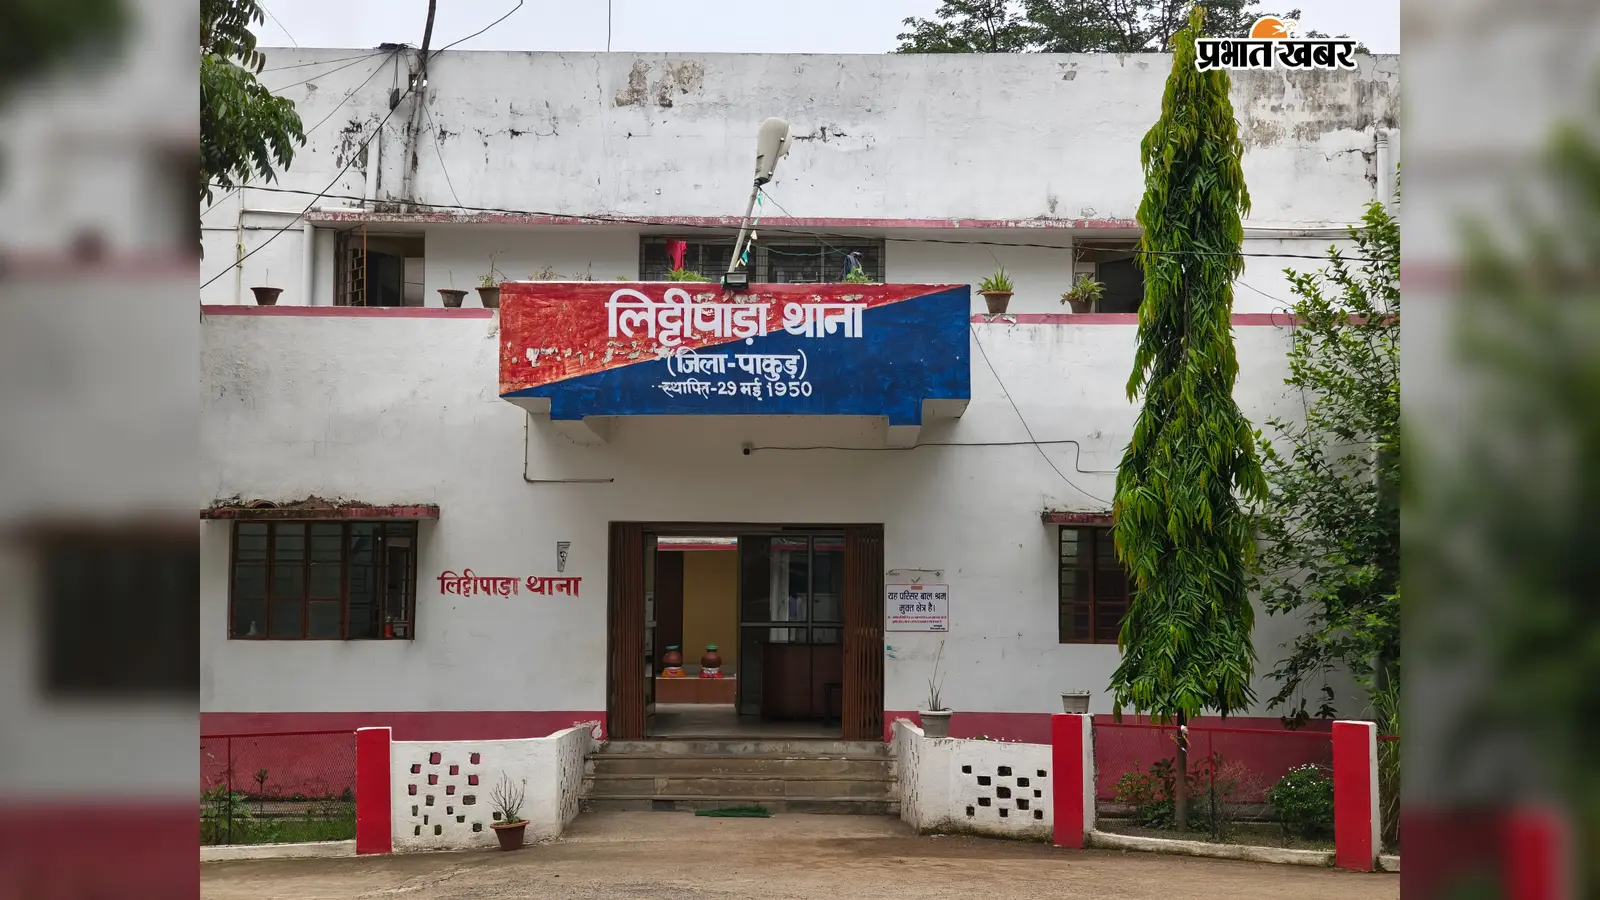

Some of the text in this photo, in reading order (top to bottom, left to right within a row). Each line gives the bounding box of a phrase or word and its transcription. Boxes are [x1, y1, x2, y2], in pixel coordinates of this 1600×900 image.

[605, 288, 867, 347] लिट्टीपाड़ा थाना
[667, 346, 808, 381] (जिला-पाकुड़)
[739, 377, 763, 401] मई
[766, 381, 813, 397] 1950
[437, 568, 582, 599] लिट्टीपाड़ा थाना
[887, 590, 947, 600] यह परिसर बाल श्रम
[915, 602, 926, 612] क्षेत्र
